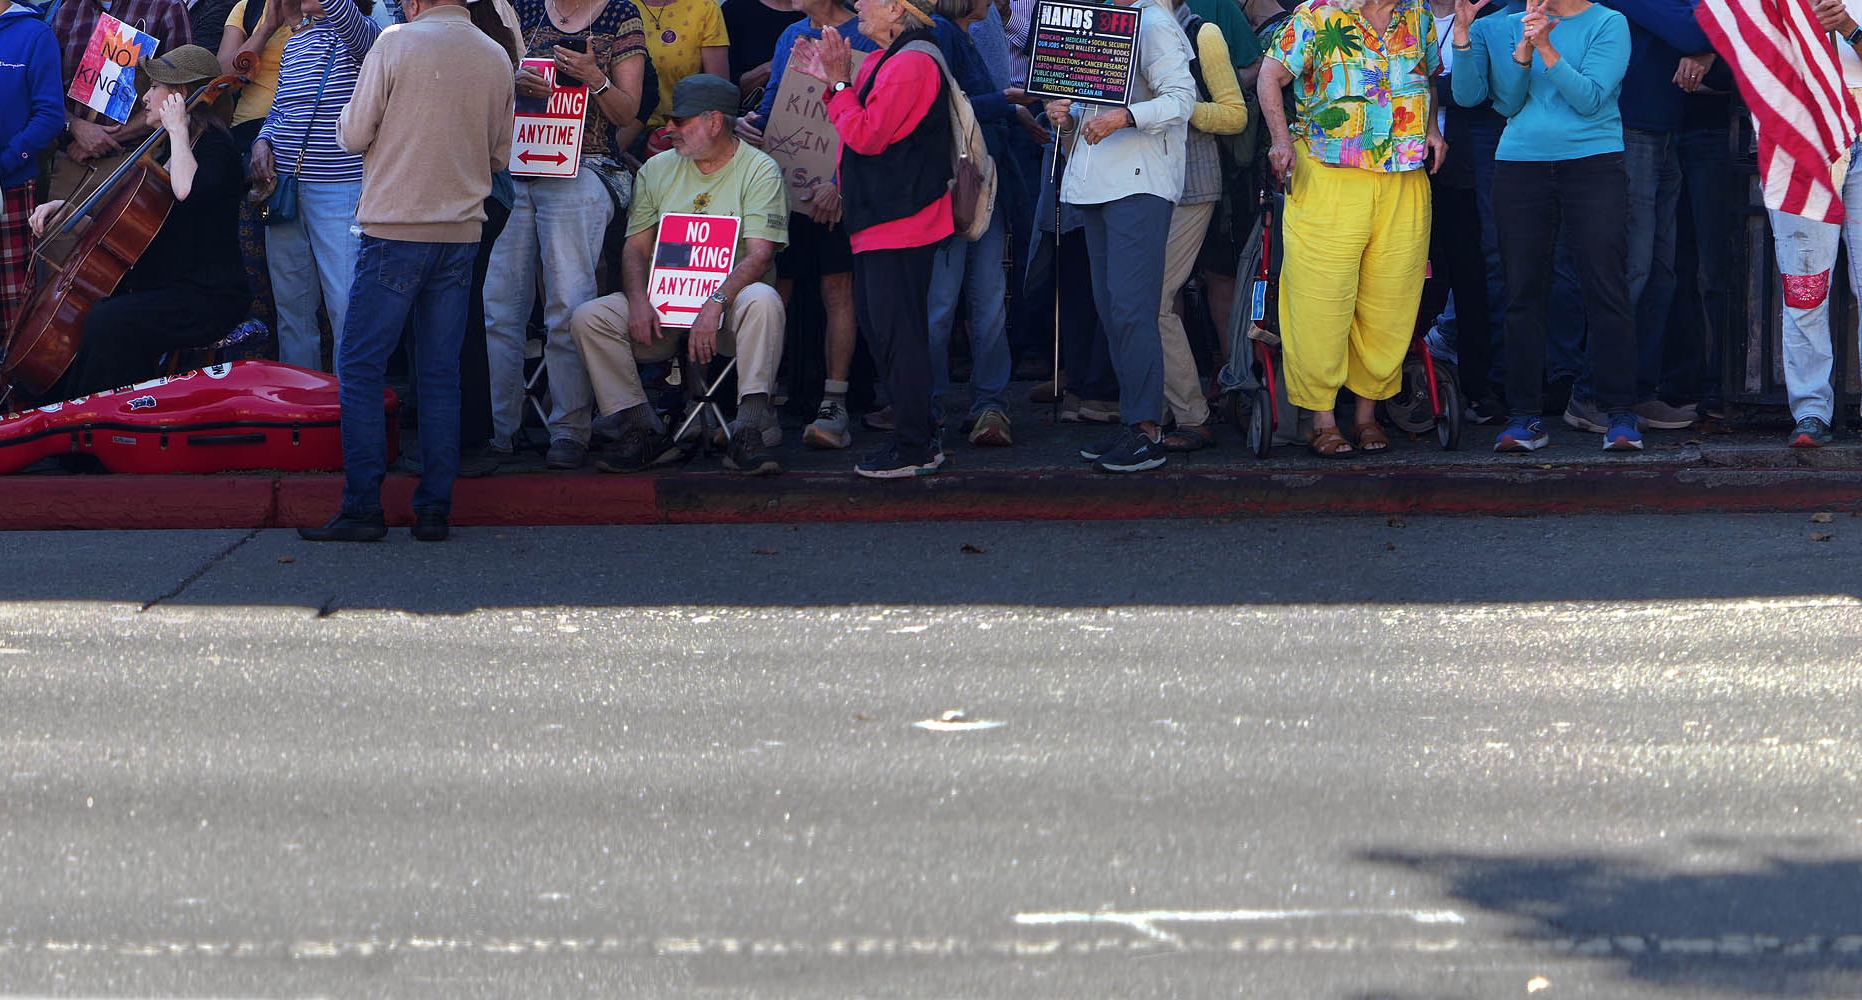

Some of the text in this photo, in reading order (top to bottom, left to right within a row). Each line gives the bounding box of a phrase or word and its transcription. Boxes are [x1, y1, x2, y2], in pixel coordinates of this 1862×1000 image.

[1041, 5, 1134, 33] HANDS OFF!
[1065, 36, 1131, 49] MEDICARE SECURITY
[101, 40, 131, 68] NO
[77, 67, 132, 103] KINGS
[1042, 84, 1074, 93] PROTECTIONS
[1060, 79, 1090, 88] IMMIGRANTS
[547, 92, 584, 115] KING
[517, 123, 575, 146] ANYTIME
[804, 131, 829, 153] IN
[685, 221, 711, 242] NO
[688, 247, 730, 269] KING
[656, 276, 720, 297] ANYTIME
